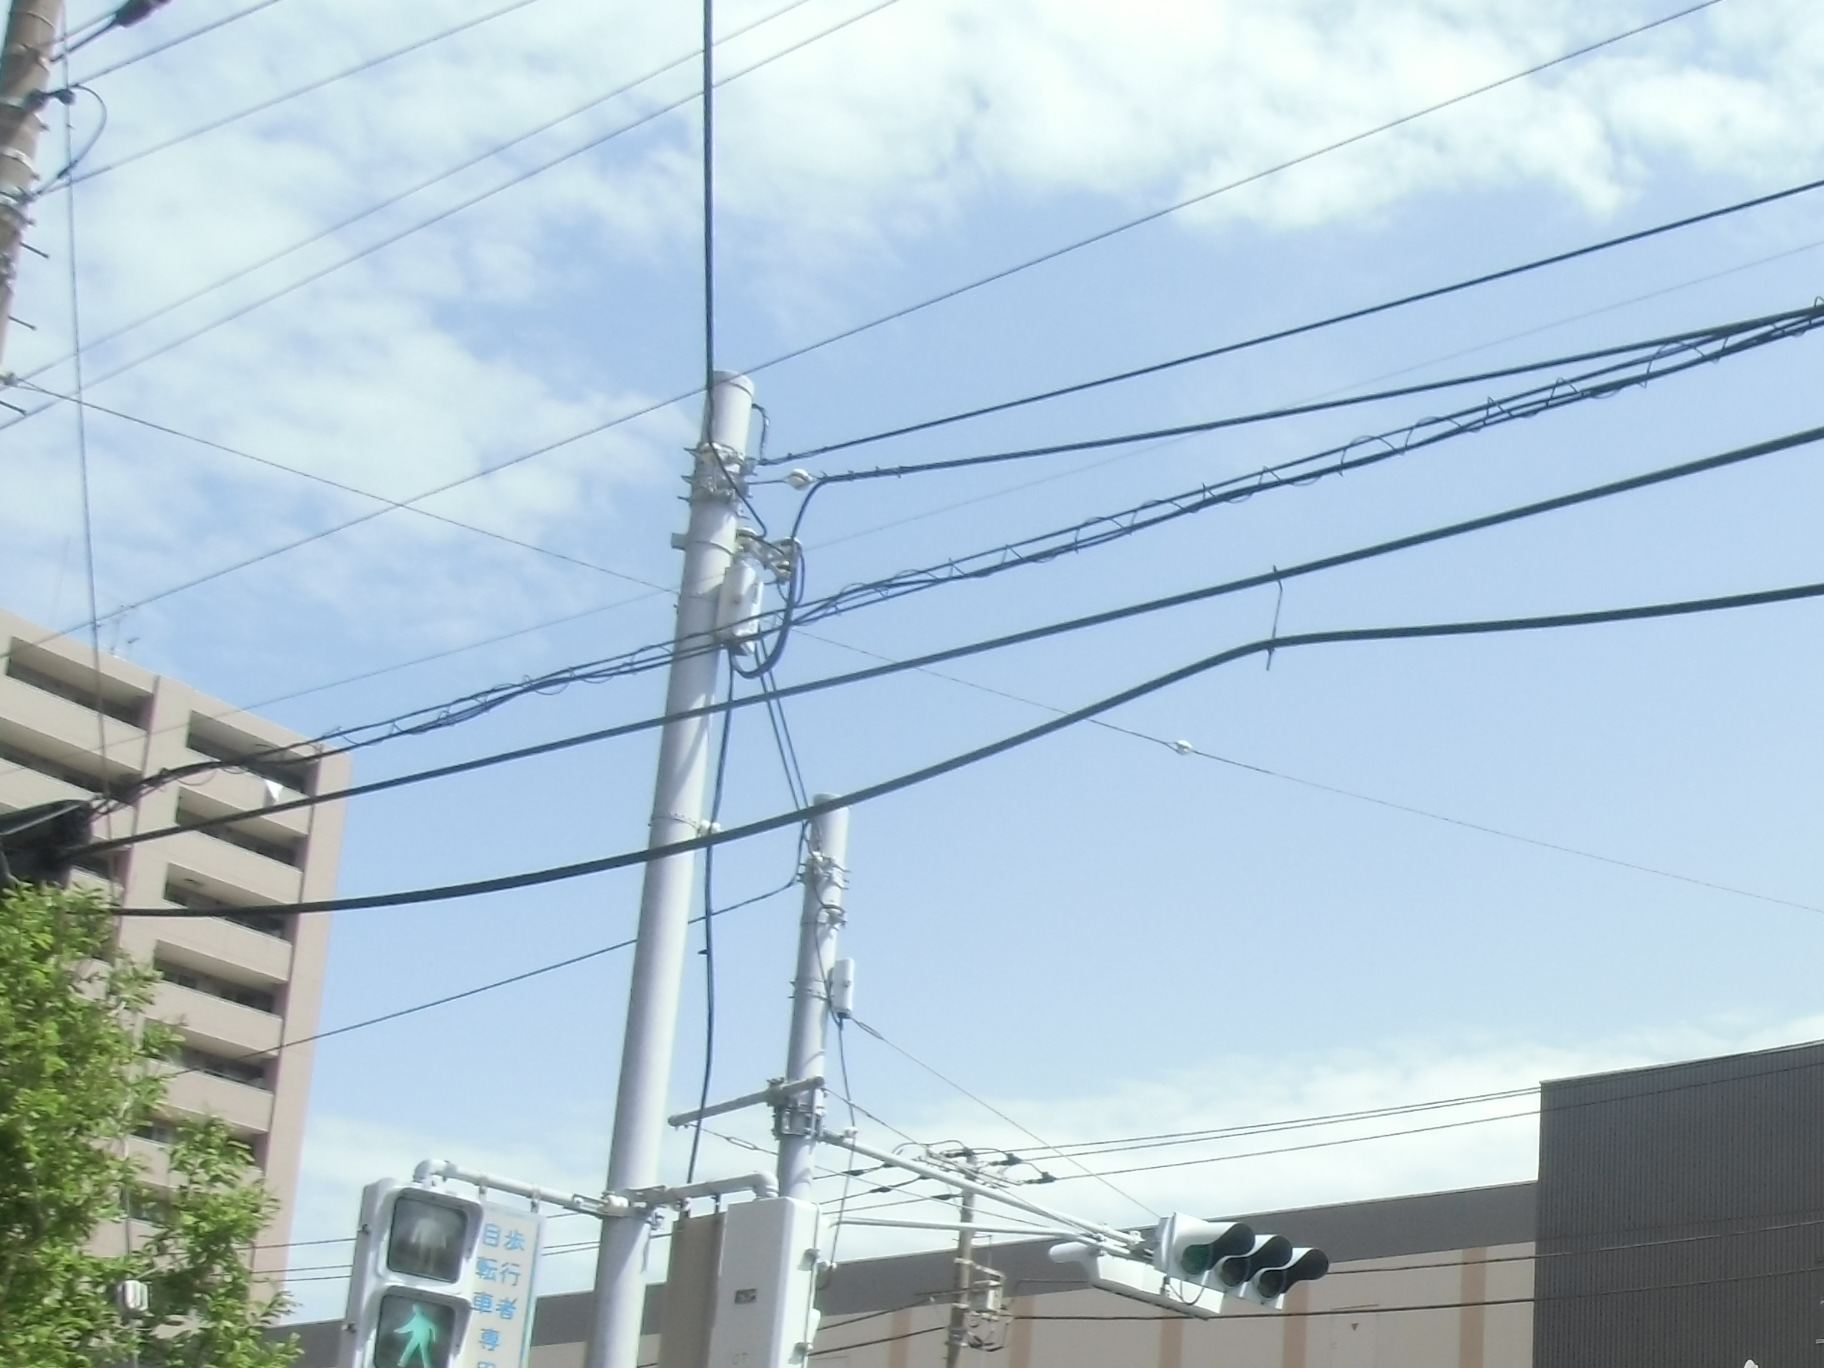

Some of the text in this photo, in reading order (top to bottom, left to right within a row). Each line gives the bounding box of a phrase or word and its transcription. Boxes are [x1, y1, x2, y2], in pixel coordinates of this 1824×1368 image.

[472, 1222, 502, 1314] 自転車
[495, 1228, 526, 1321] 歩行者
